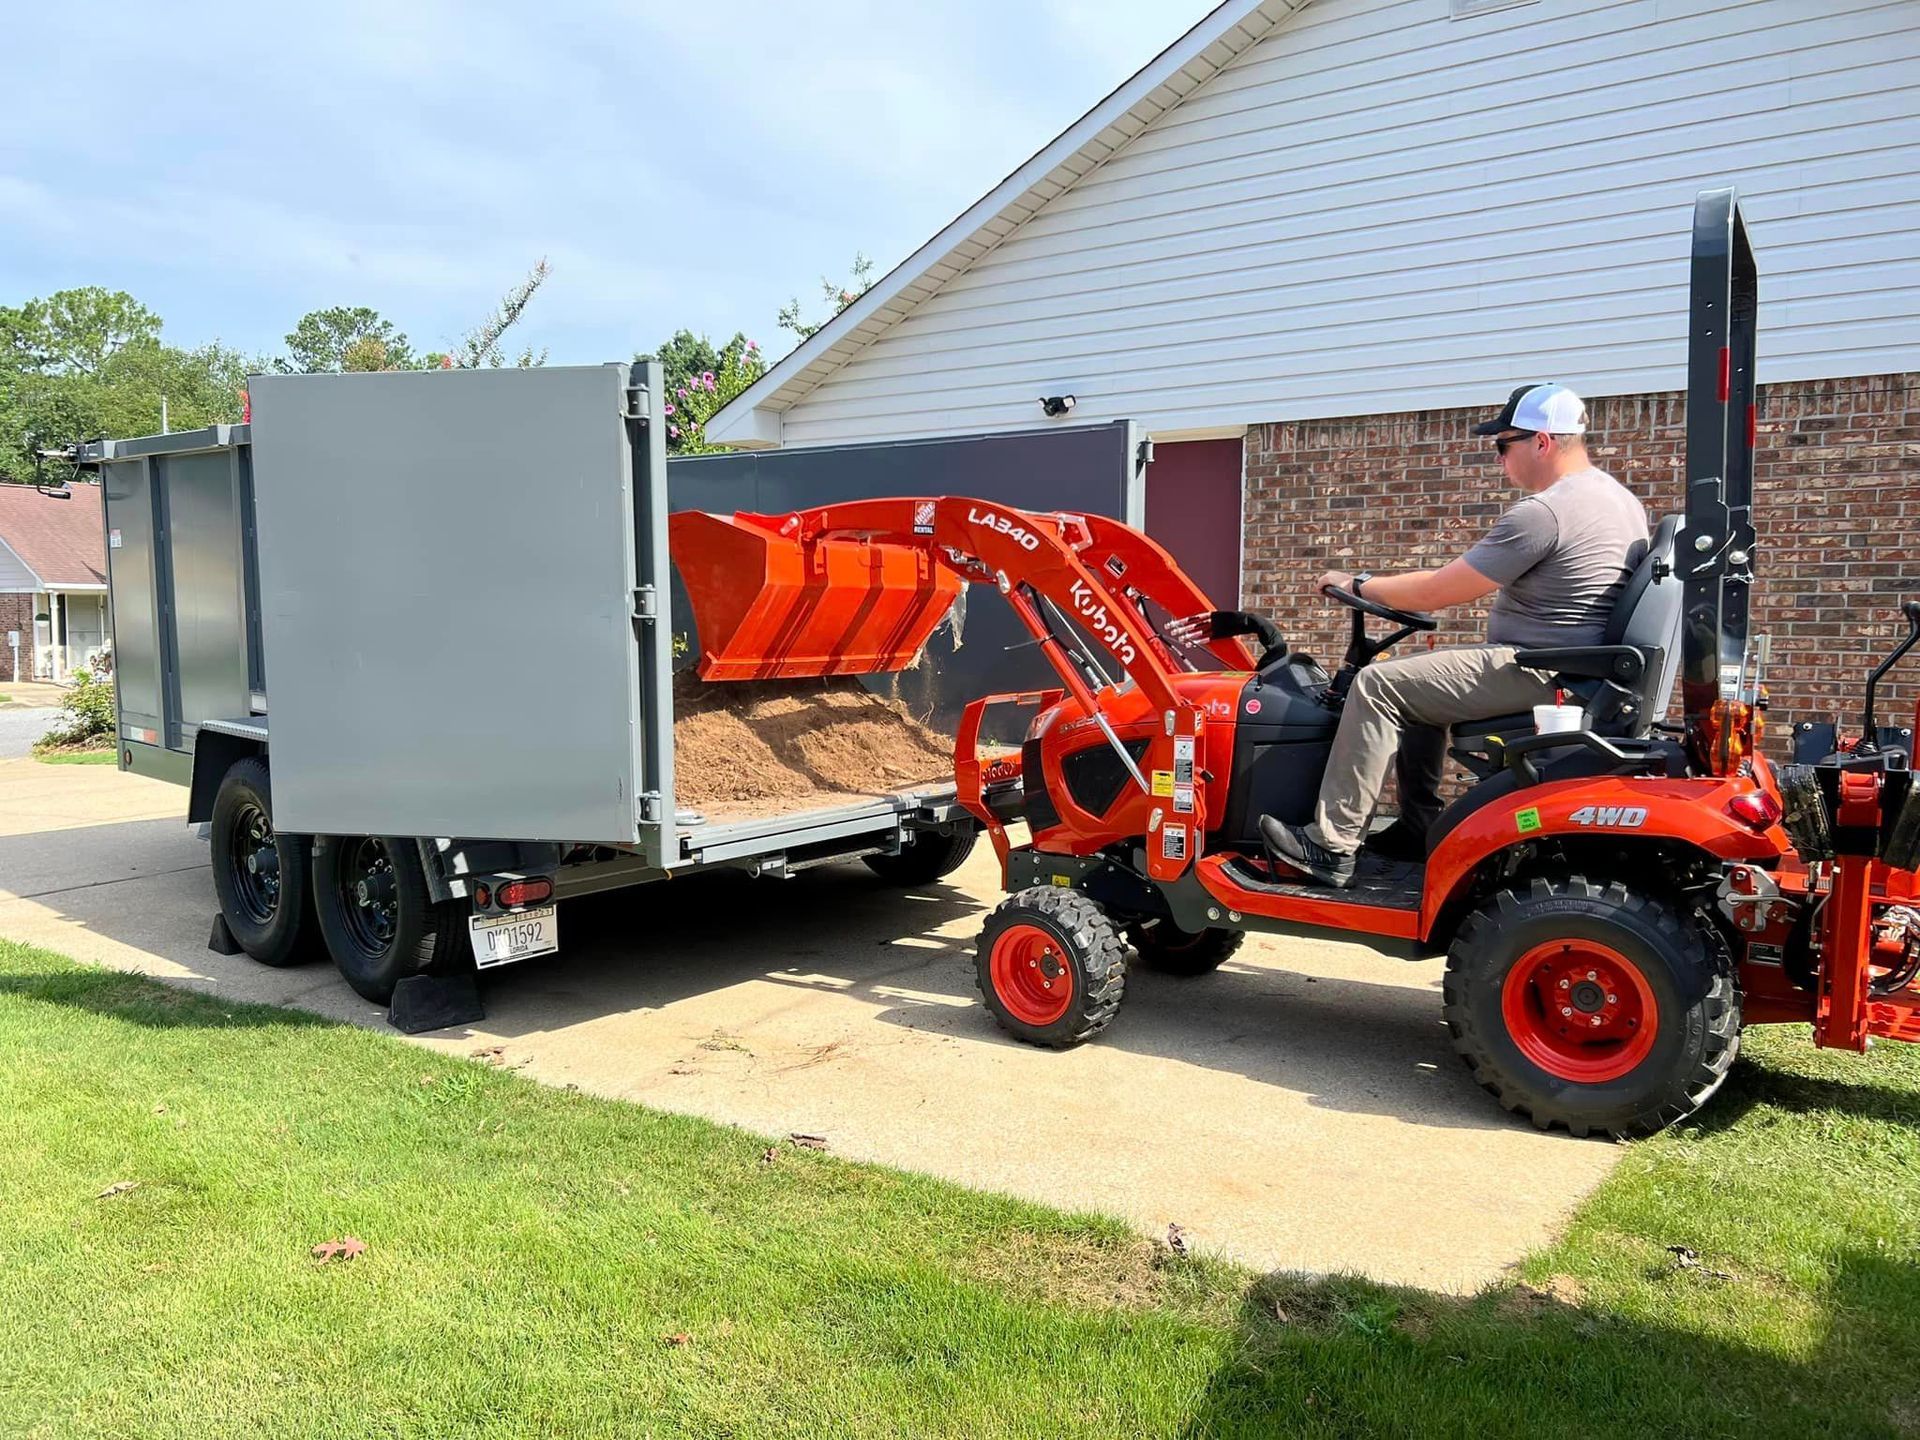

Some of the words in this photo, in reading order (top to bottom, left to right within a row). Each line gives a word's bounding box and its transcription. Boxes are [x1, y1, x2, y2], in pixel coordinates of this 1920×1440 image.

[968, 508, 1040, 551] LA340
[1069, 579, 1136, 665] Kubota
[1568, 806, 1648, 827] 4WD
